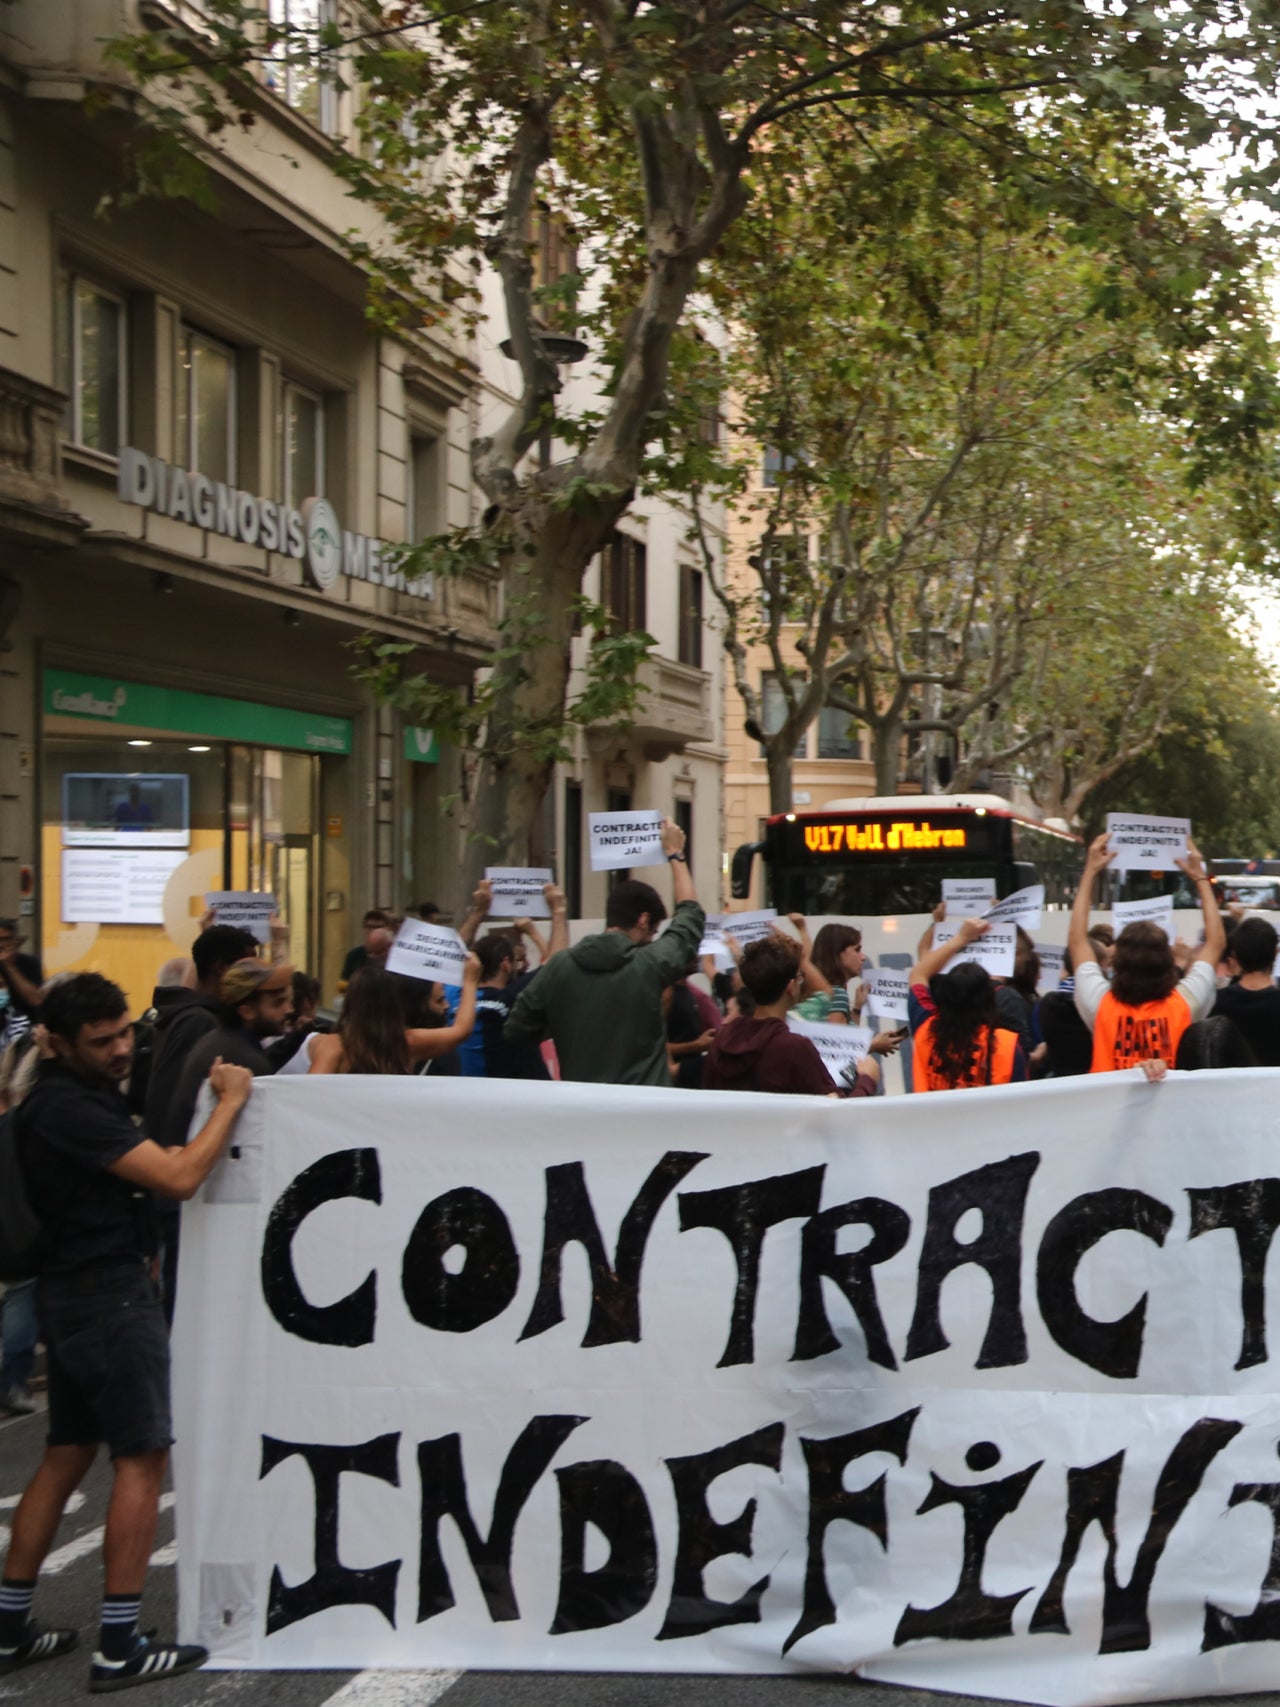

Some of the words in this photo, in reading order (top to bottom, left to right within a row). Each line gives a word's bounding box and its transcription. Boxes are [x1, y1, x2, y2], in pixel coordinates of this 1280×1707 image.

[118, 446, 305, 559] DIAGNOSIS
[593, 821, 663, 833] CONTRACTE
[1111, 824, 1187, 834] CONTRACTES
[805, 825, 844, 851] V17
[846, 824, 884, 850] Vall
[1116, 836, 1181, 846] INDEFINITS
[624, 847, 642, 855] JA!
[1140, 849, 1158, 857] JA!
[397, 940, 465, 962] MARICARME
[877, 979, 908, 988] DECRET
